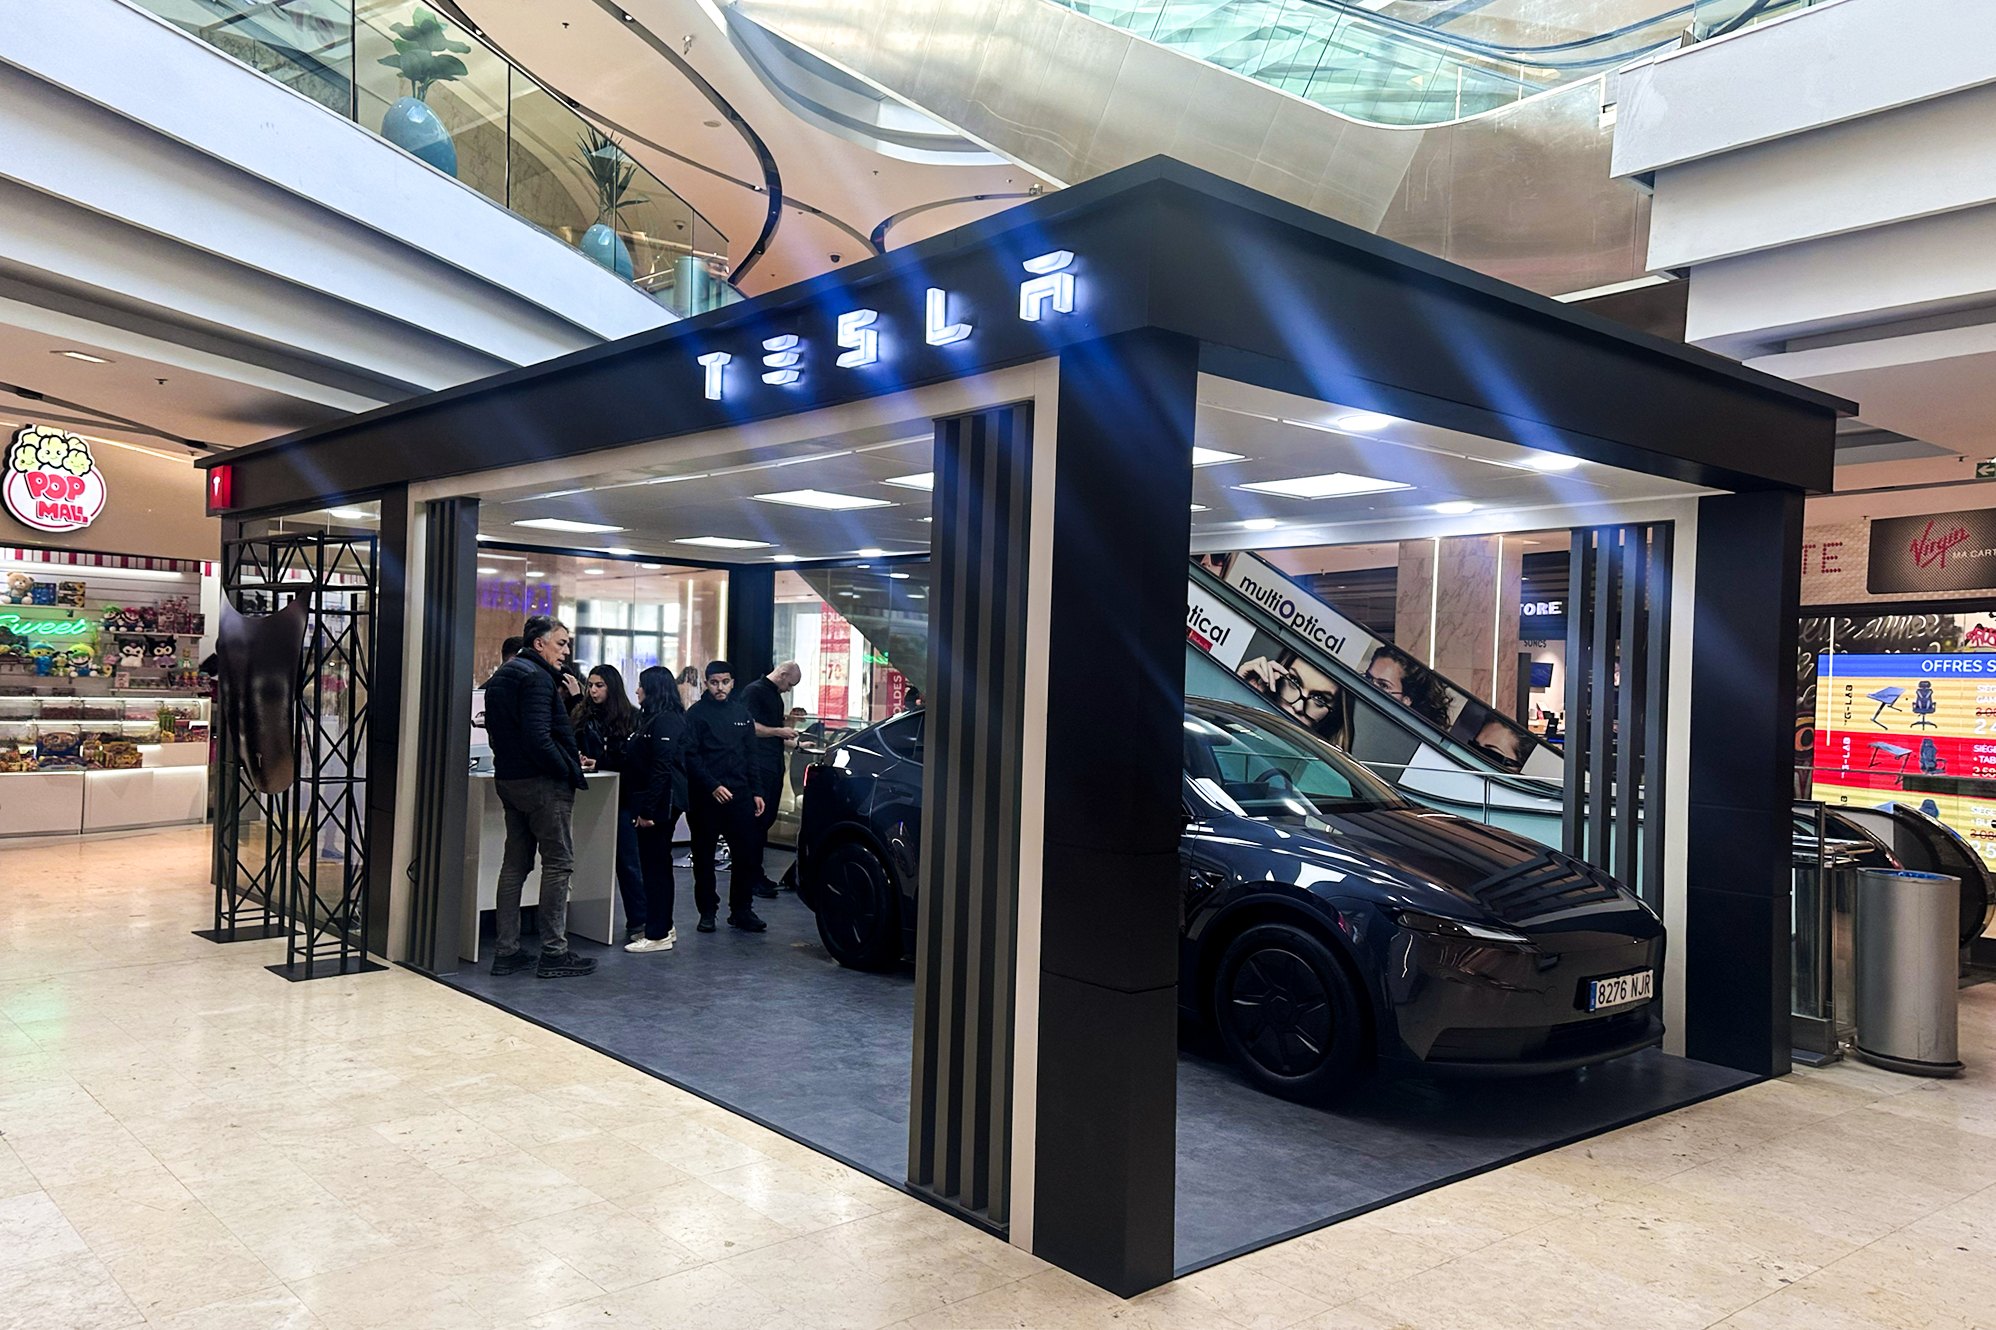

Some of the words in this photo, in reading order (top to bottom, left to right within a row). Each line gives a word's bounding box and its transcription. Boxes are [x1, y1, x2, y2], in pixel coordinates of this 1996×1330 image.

[697, 250, 1075, 401] TESLA
[26, 471, 86, 500] POP
[37, 501, 88, 525] MALL
[1909, 520, 1970, 569] Virgin
[1187, 604, 1231, 647] tical
[1239, 576, 1346, 654] multiOptical
[1921, 659, 1983, 672] OFFRES
[1598, 980, 1627, 1005] 8276
[1631, 974, 1650, 998] NJR
